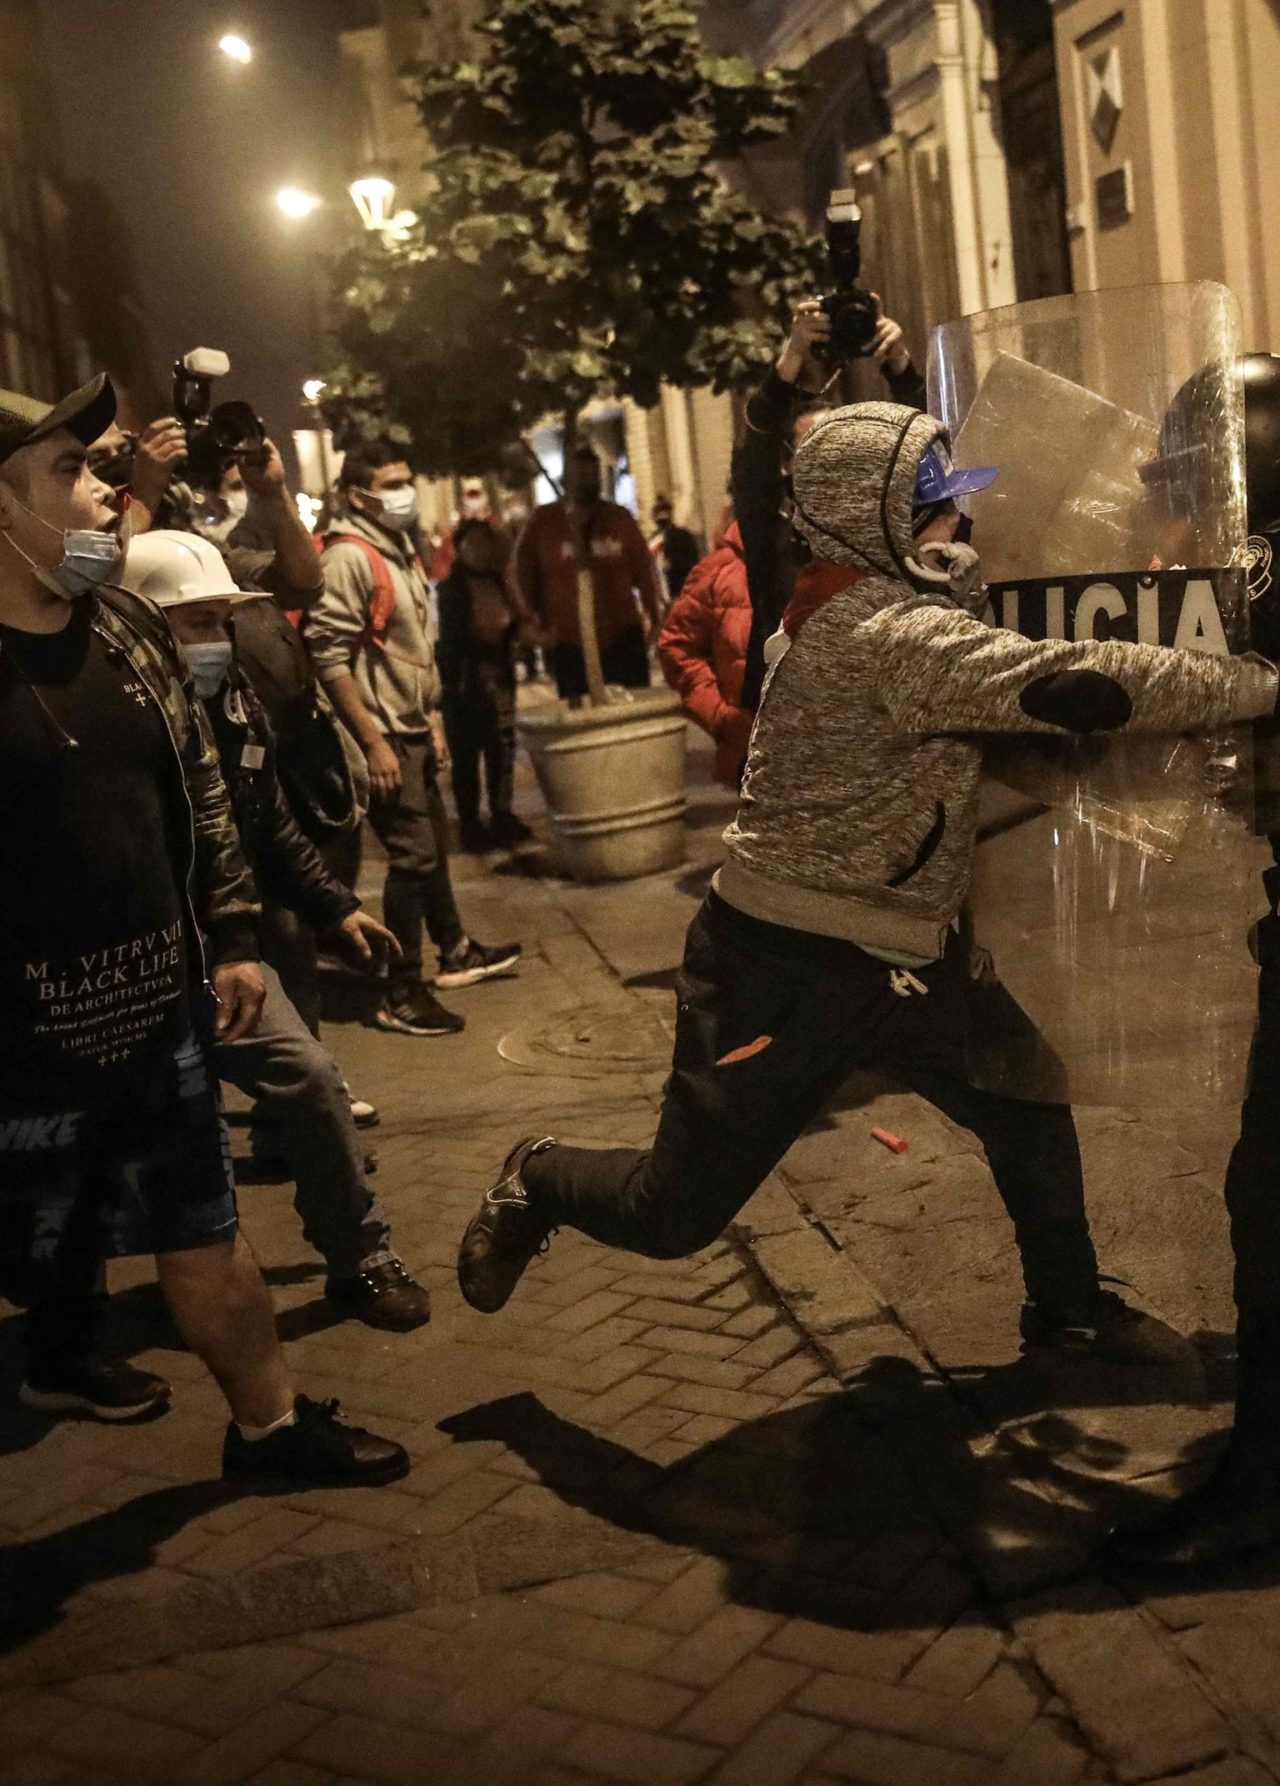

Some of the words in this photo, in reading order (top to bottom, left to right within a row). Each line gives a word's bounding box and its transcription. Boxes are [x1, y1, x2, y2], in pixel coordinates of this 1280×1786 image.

[40, 965, 129, 1000] BLACK
[139, 945, 179, 977] LIFE
[50, 1003, 71, 1017] DE
